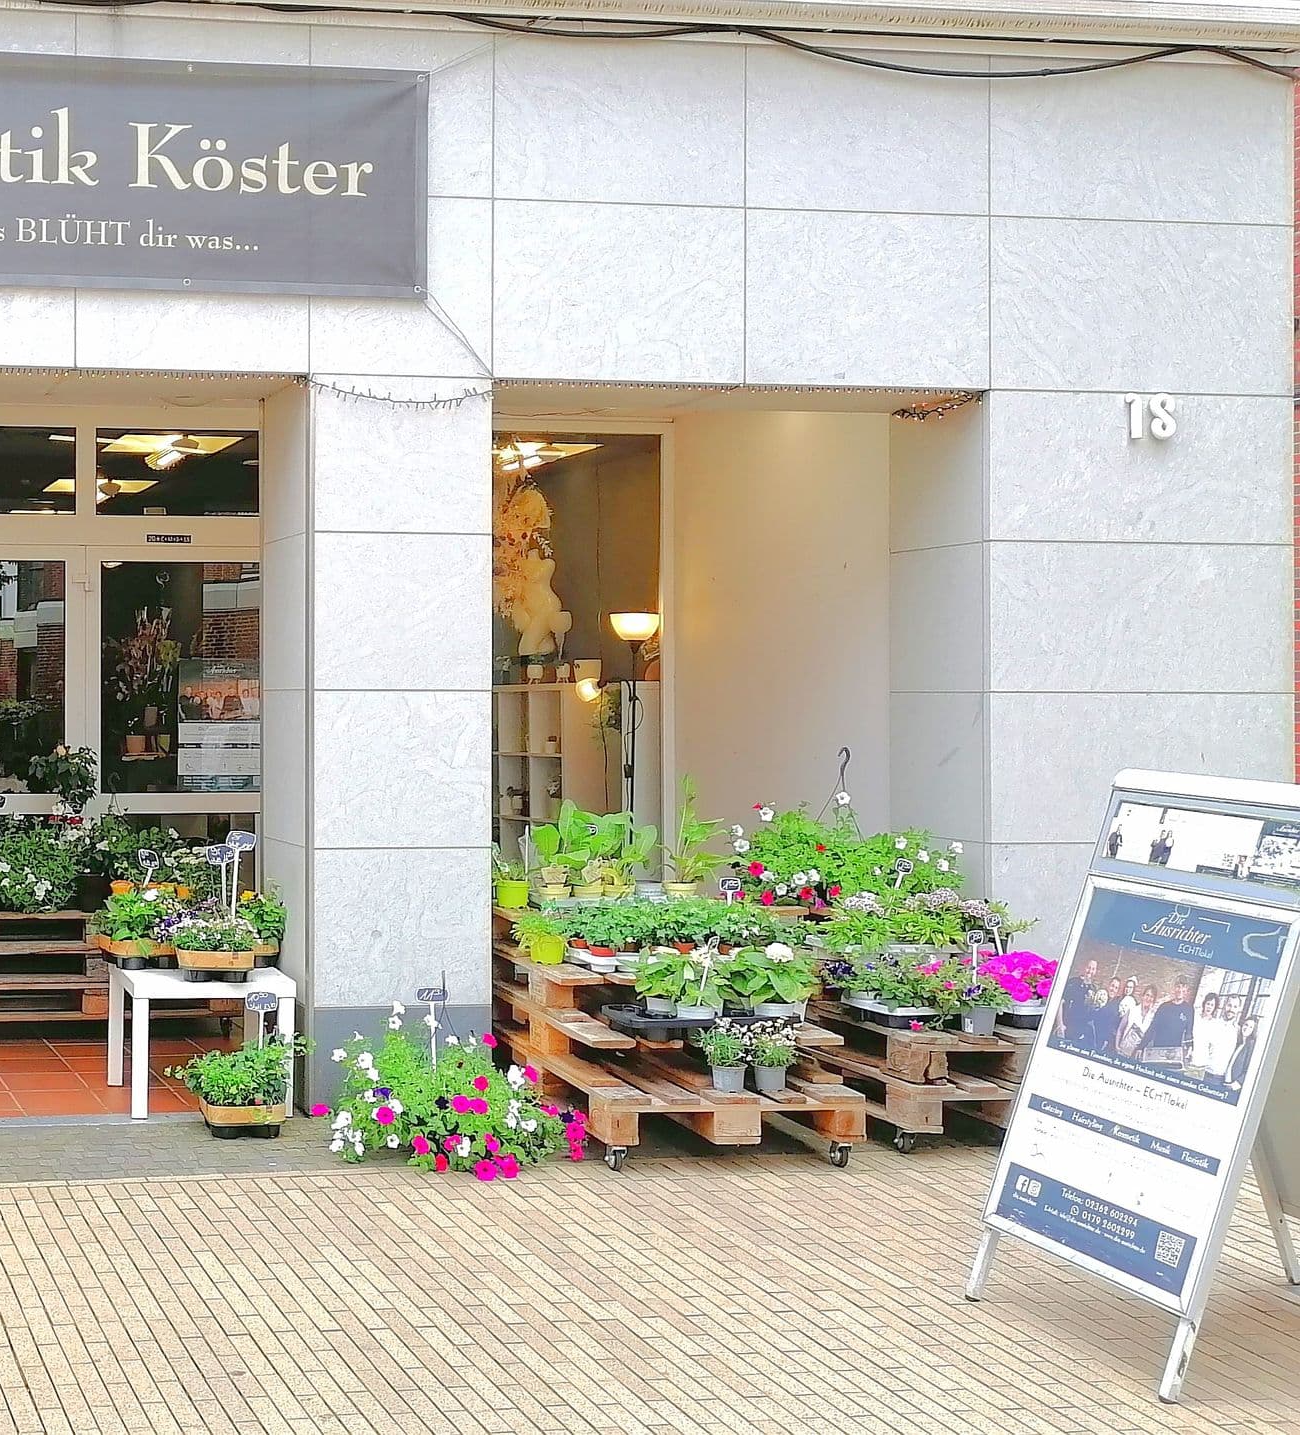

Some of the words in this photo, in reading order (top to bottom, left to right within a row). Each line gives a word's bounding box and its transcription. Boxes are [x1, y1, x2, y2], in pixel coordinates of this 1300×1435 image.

[128, 121, 374, 198] Köster
[15, 212, 131, 247] BLÜHT
[138, 225, 177, 249] dir
[1124, 392, 1177, 439] 18
[1141, 917, 1212, 945] Ausrichter
[1082, 1066, 1096, 1079] Die
[1097, 1072, 1134, 1093] Ausrichter
[1041, 1101, 1064, 1119] Catering
[1071, 1111, 1104, 1132] Hairstyling
[1112, 1124, 1141, 1145] Kosmetik
[1151, 1140, 1171, 1155] Musik
[1181, 1151, 1210, 1169] Floristik
[1081, 1210, 1101, 1225] 0179
[1101, 1219, 1136, 1240] 2602299
[1085, 1196, 1109, 1215] 02362
[1109, 1207, 1139, 1227] 602294
